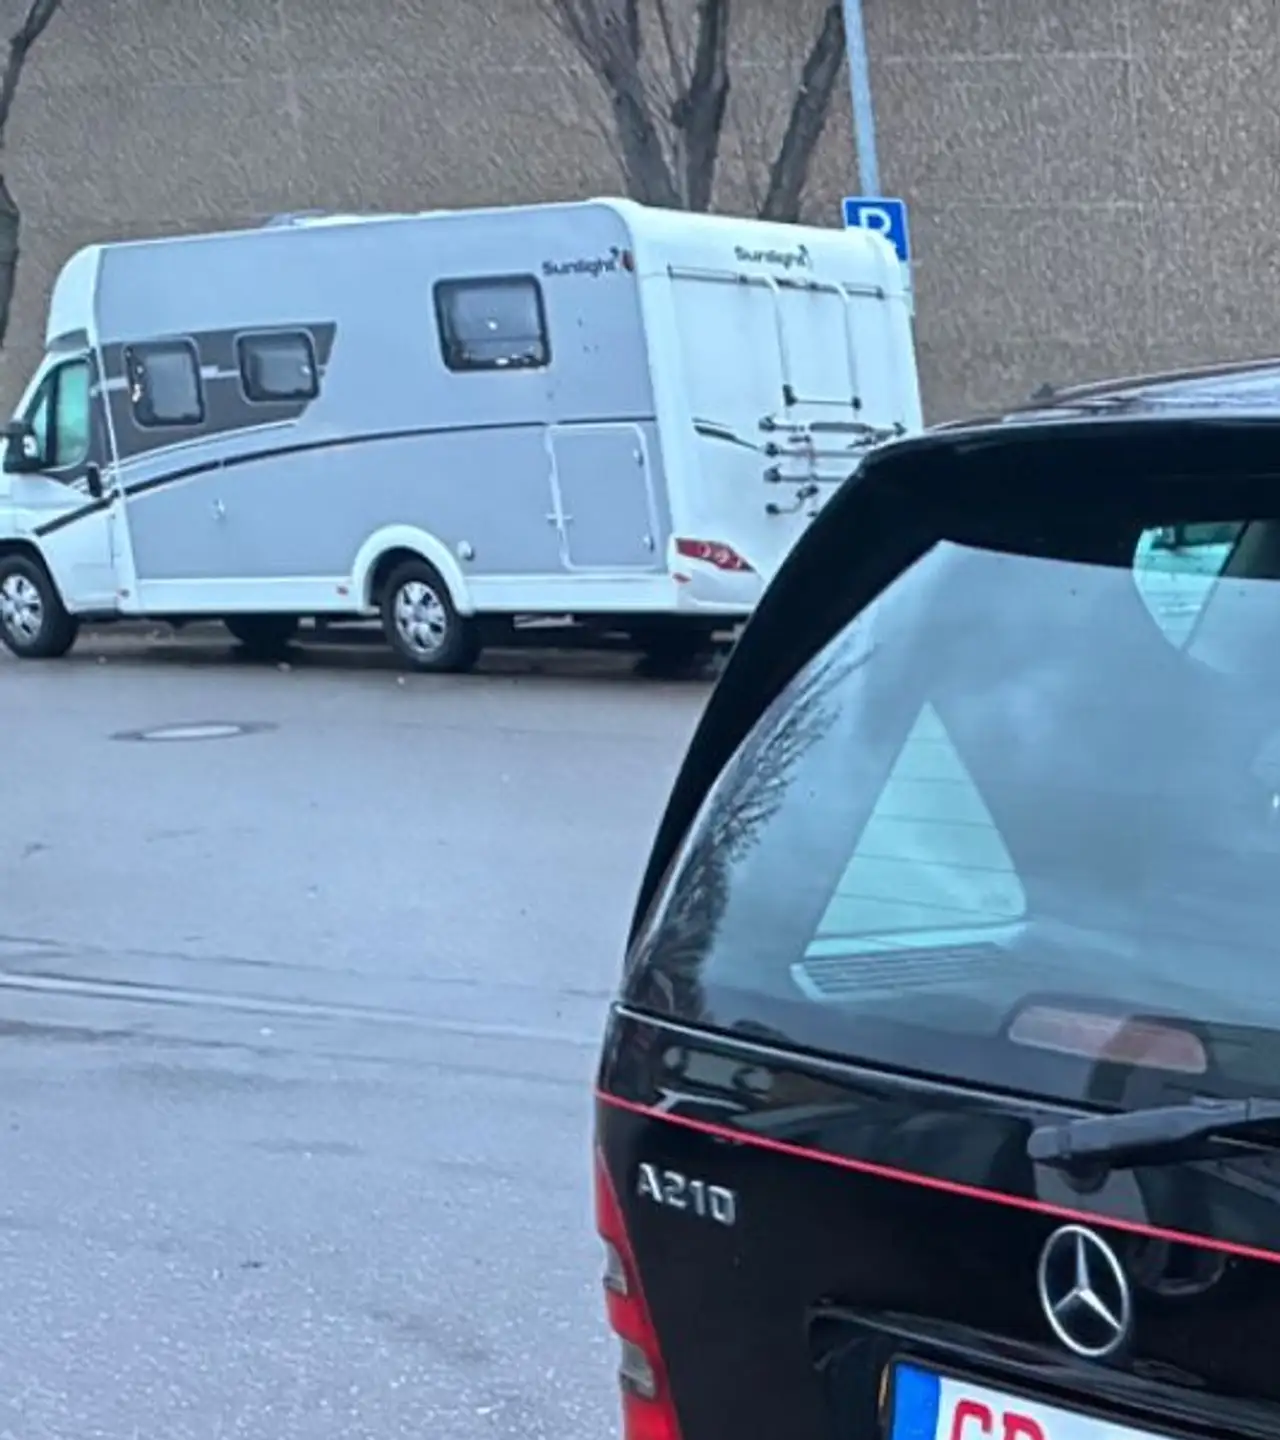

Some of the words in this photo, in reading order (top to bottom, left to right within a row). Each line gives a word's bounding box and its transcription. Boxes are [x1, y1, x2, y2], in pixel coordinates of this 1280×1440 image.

[542, 246, 619, 278] Sunlight
[734, 244, 808, 270] Sunlight
[638, 1162, 736, 1226] A210
